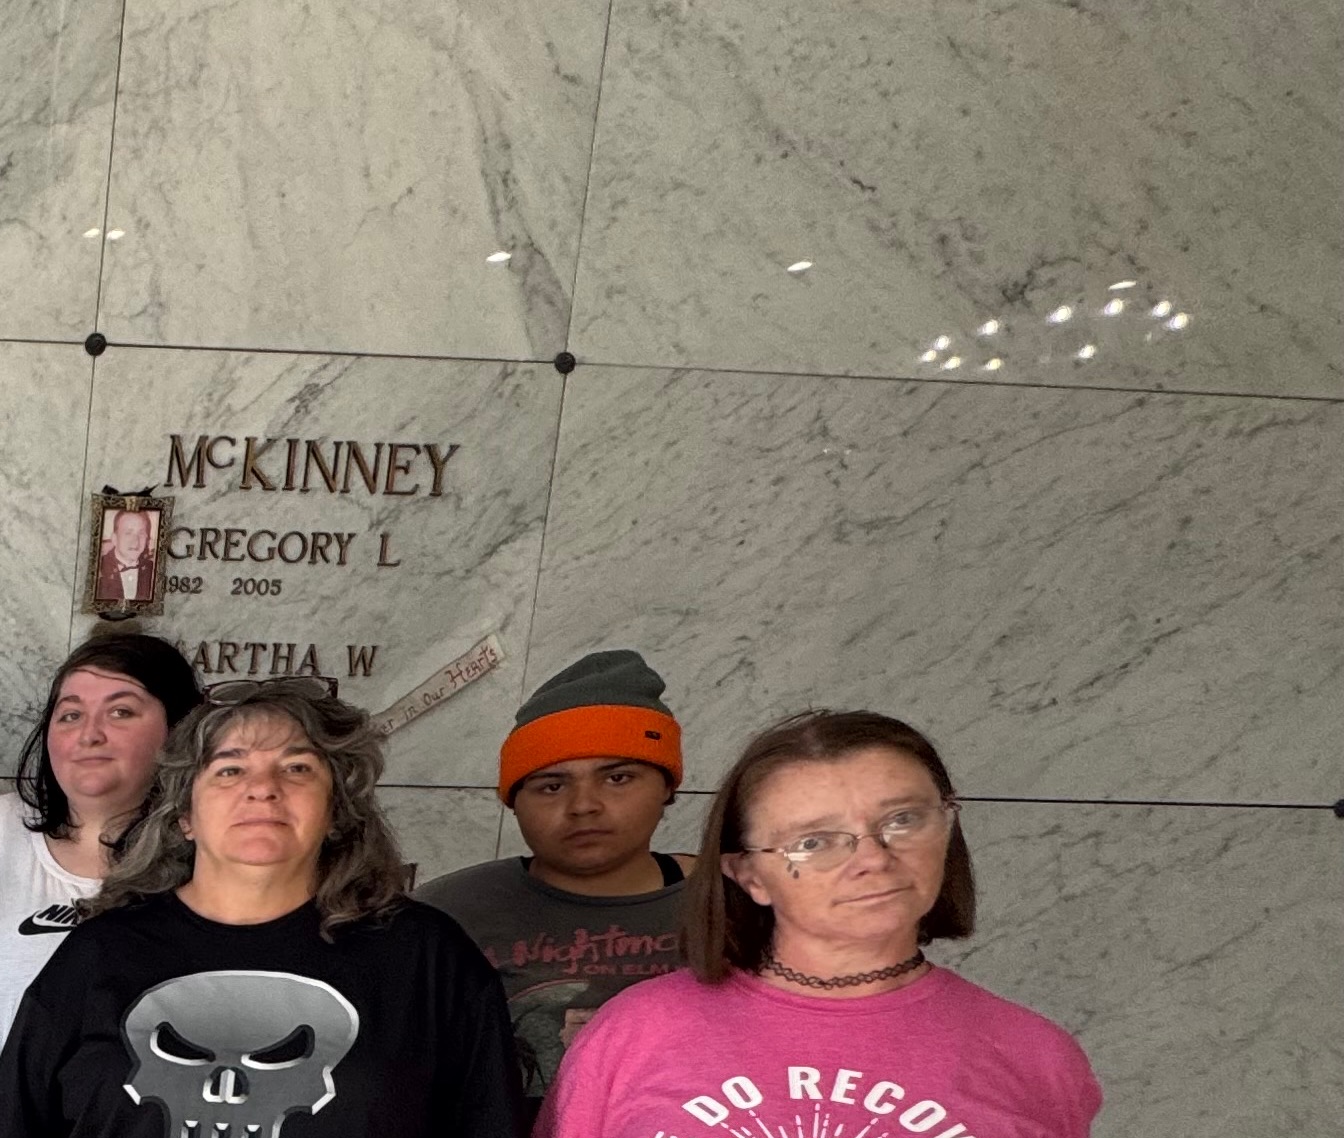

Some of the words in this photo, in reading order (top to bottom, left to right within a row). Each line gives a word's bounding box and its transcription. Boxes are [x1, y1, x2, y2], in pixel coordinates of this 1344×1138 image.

[166, 527, 357, 565] GREGORY
[377, 531, 401, 567] L
[231, 577, 282, 596] 2005
[182, 640, 321, 676] ARTHA
[346, 644, 379, 677] W
[681, 1075, 763, 1127] DO
